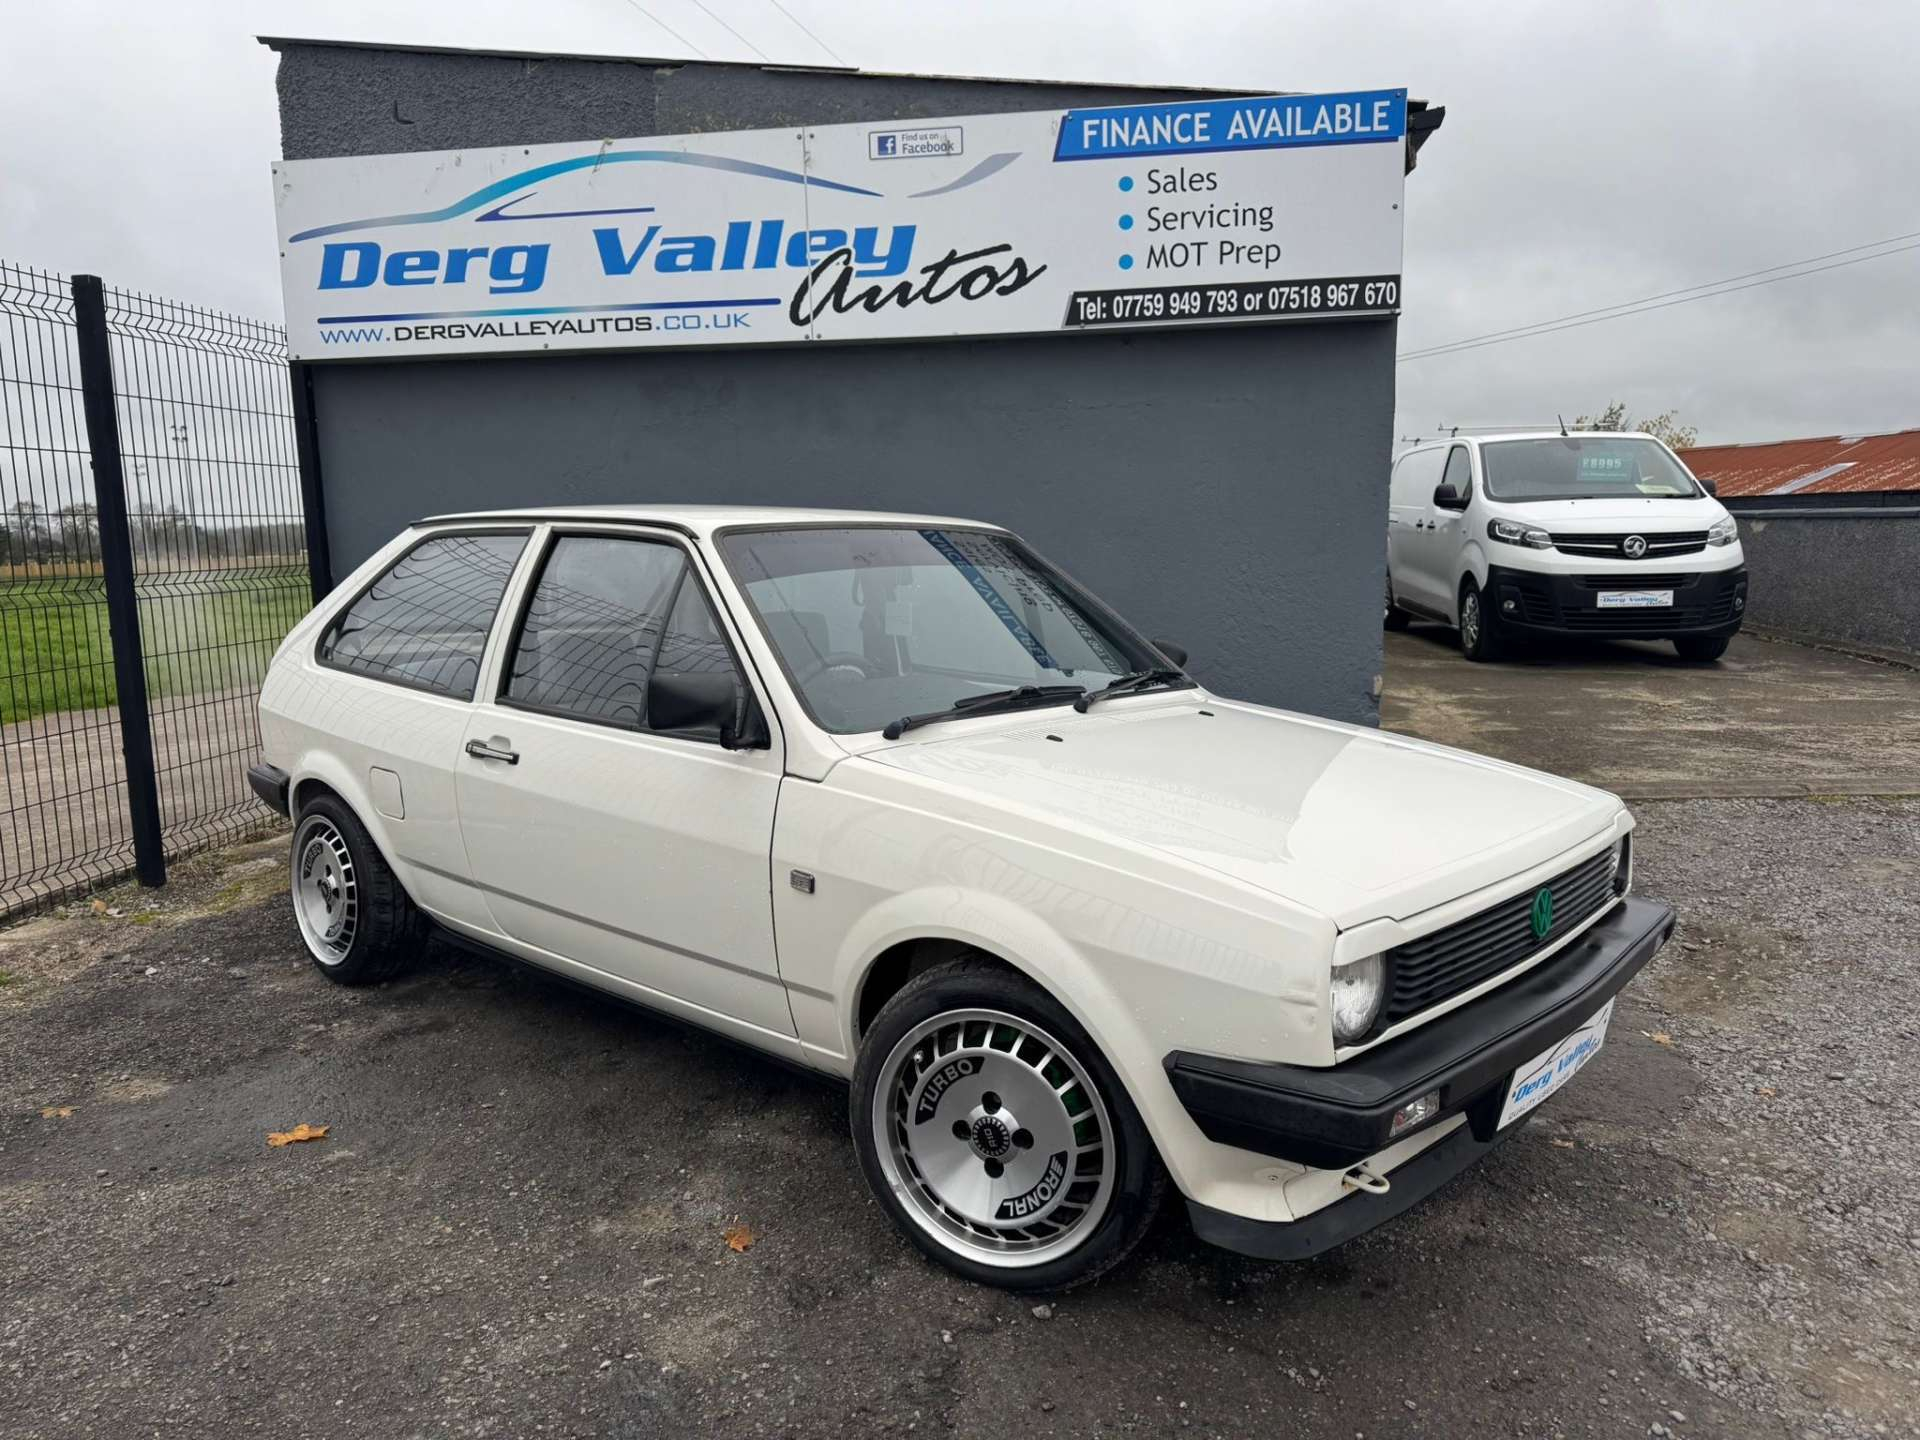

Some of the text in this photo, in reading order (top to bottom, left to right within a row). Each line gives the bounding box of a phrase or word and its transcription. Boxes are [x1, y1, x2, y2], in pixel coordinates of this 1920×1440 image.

[902, 133, 918, 141] Find
[929, 133, 939, 142] on
[1083, 100, 1391, 149] FINANCE AVAILABLE
[902, 140, 955, 154] Facebook
[1147, 167, 1218, 194] Sales
[1147, 202, 1274, 232] Servicing
[317, 219, 917, 294] Derg Valley
[1146, 240, 1281, 269] MOT Prep
[789, 244, 1048, 327] Autos
[1077, 281, 1397, 320] Tel: 07759 949 793 or 07518 967 670
[920, 1059, 973, 1111] TURBO
[1003, 1169, 1060, 1217] RONAL
